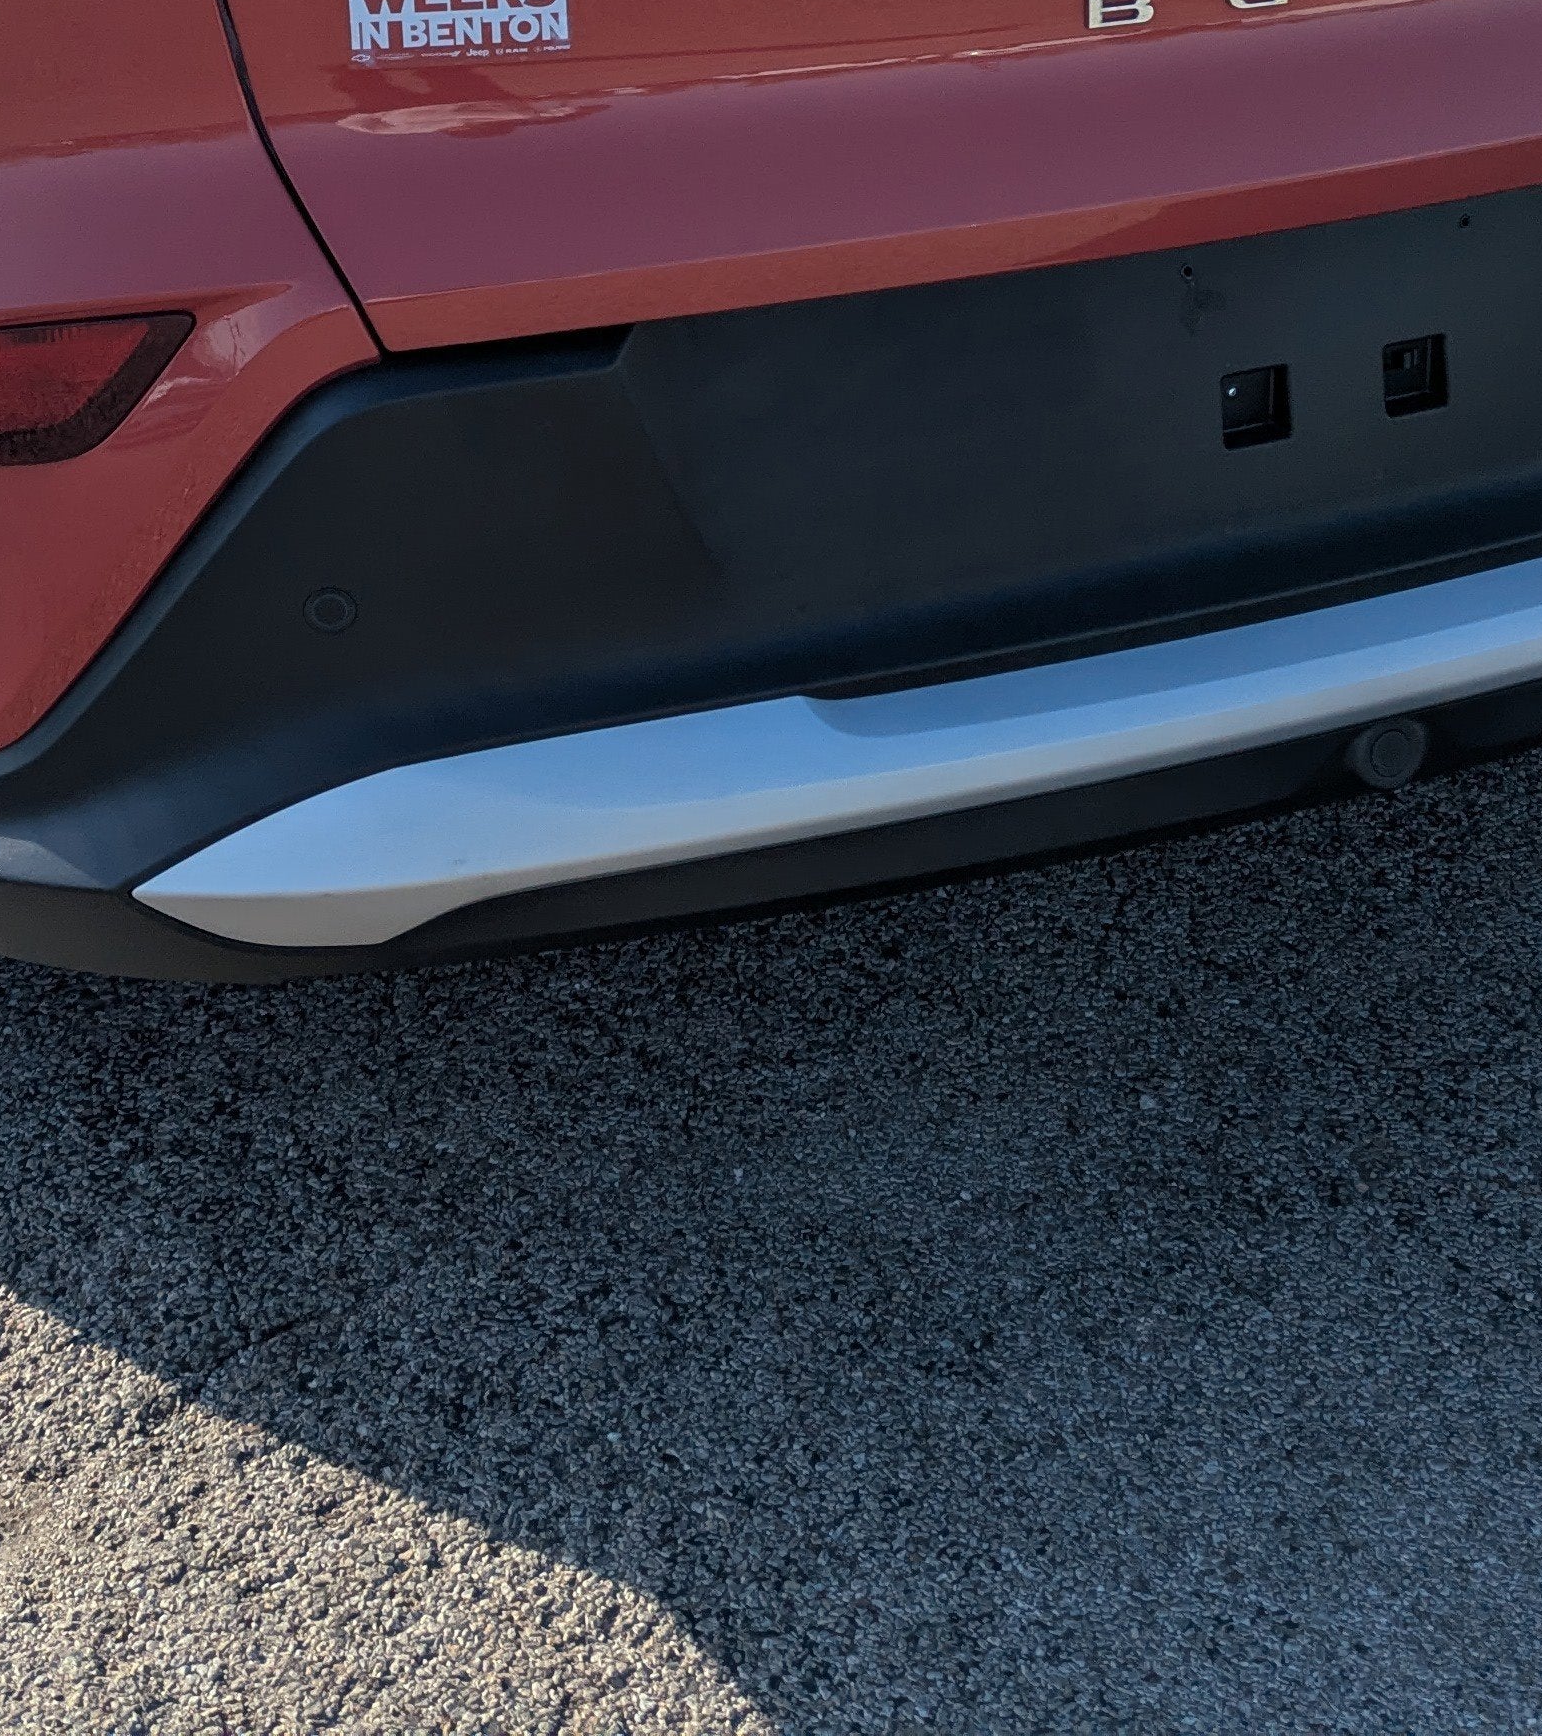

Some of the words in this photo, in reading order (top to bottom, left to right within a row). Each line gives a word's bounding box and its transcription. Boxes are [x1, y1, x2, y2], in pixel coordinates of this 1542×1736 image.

[351, 19, 390, 51] IN
[402, 12, 569, 49] BENTON
[466, 48, 490, 57] Jeep
